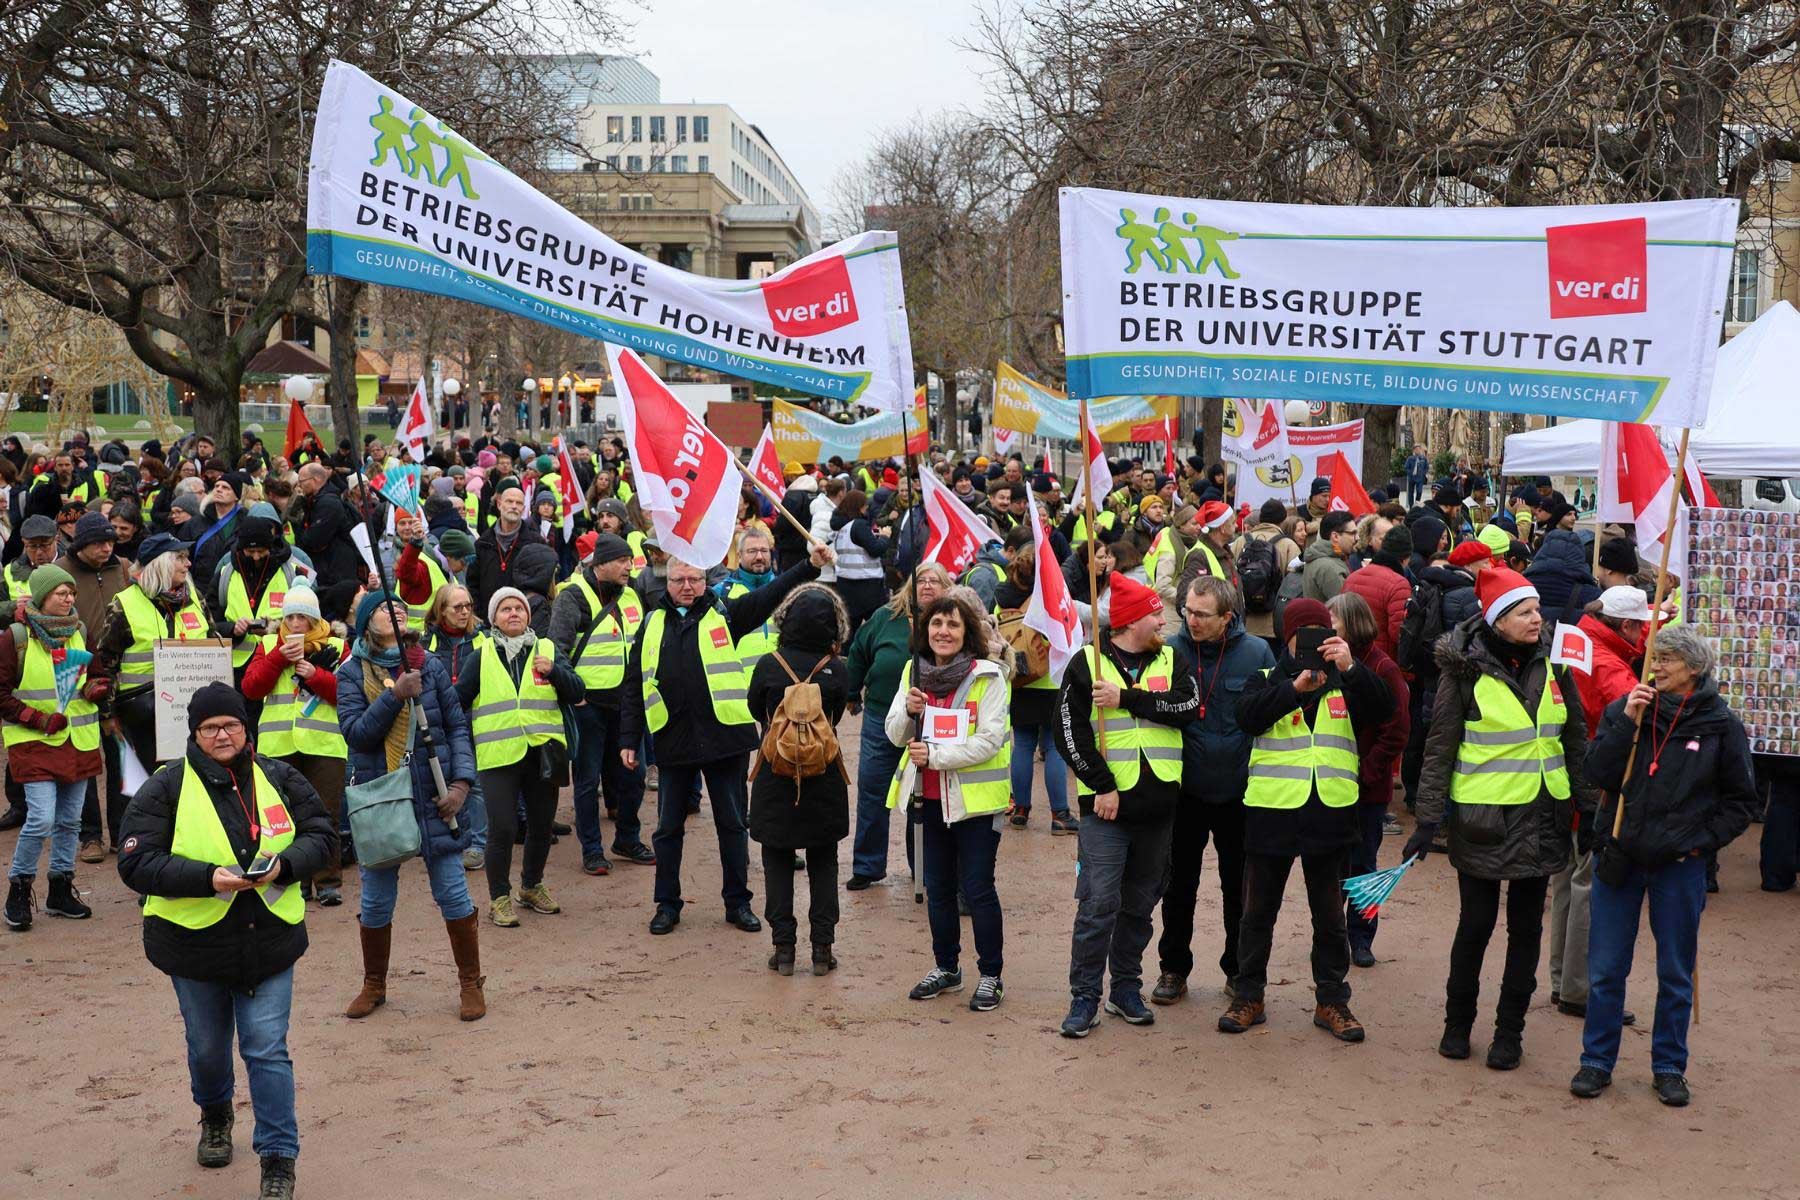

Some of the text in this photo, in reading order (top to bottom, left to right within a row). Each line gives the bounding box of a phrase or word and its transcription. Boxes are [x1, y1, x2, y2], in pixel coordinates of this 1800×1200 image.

[361, 171, 648, 287] BETRIEBSGRUPPE
[356, 204, 866, 366] DER UNIVERSITÄT HOHENHEIM
[1120, 281, 1422, 317] BETRIEBSGRUPPE
[1556, 277, 1640, 300] ver.di
[356, 250, 460, 283] GESUNDHEIT,
[684, 346, 719, 364] UND
[775, 291, 850, 323] ver.di
[1120, 317, 1652, 366] DER UNIVERSITÄT STUTTGART
[1121, 365, 1639, 405] GESUNDHEIT, SOZIALE DIENSTE, BILDUNG UND WISSENSCHAFT
[174, 662, 213, 671] Arbeitsplatz
